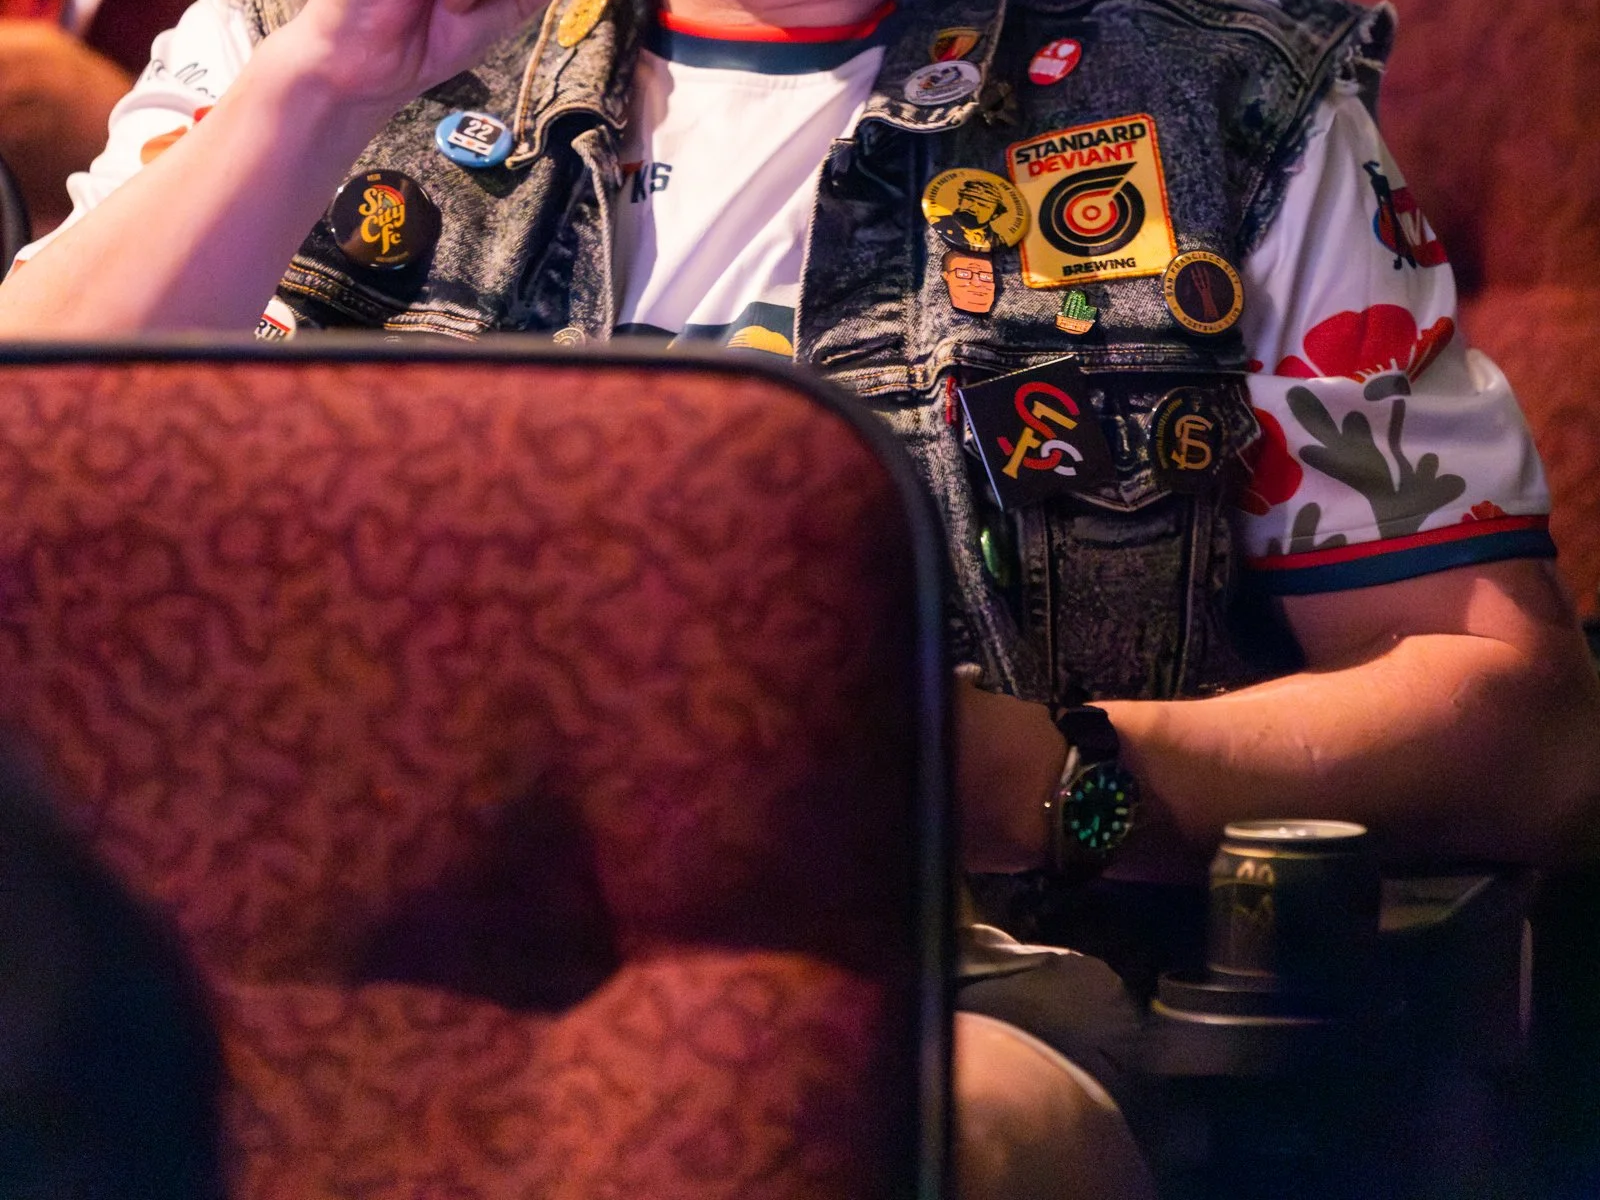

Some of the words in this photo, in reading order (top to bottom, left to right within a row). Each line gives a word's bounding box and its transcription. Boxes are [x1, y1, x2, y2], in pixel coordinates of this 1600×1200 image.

[463, 119, 494, 142] 22
[1014, 122, 1147, 165] STANDARD
[1028, 141, 1137, 178] DEVIANT
[1063, 257, 1136, 277] BREWING
